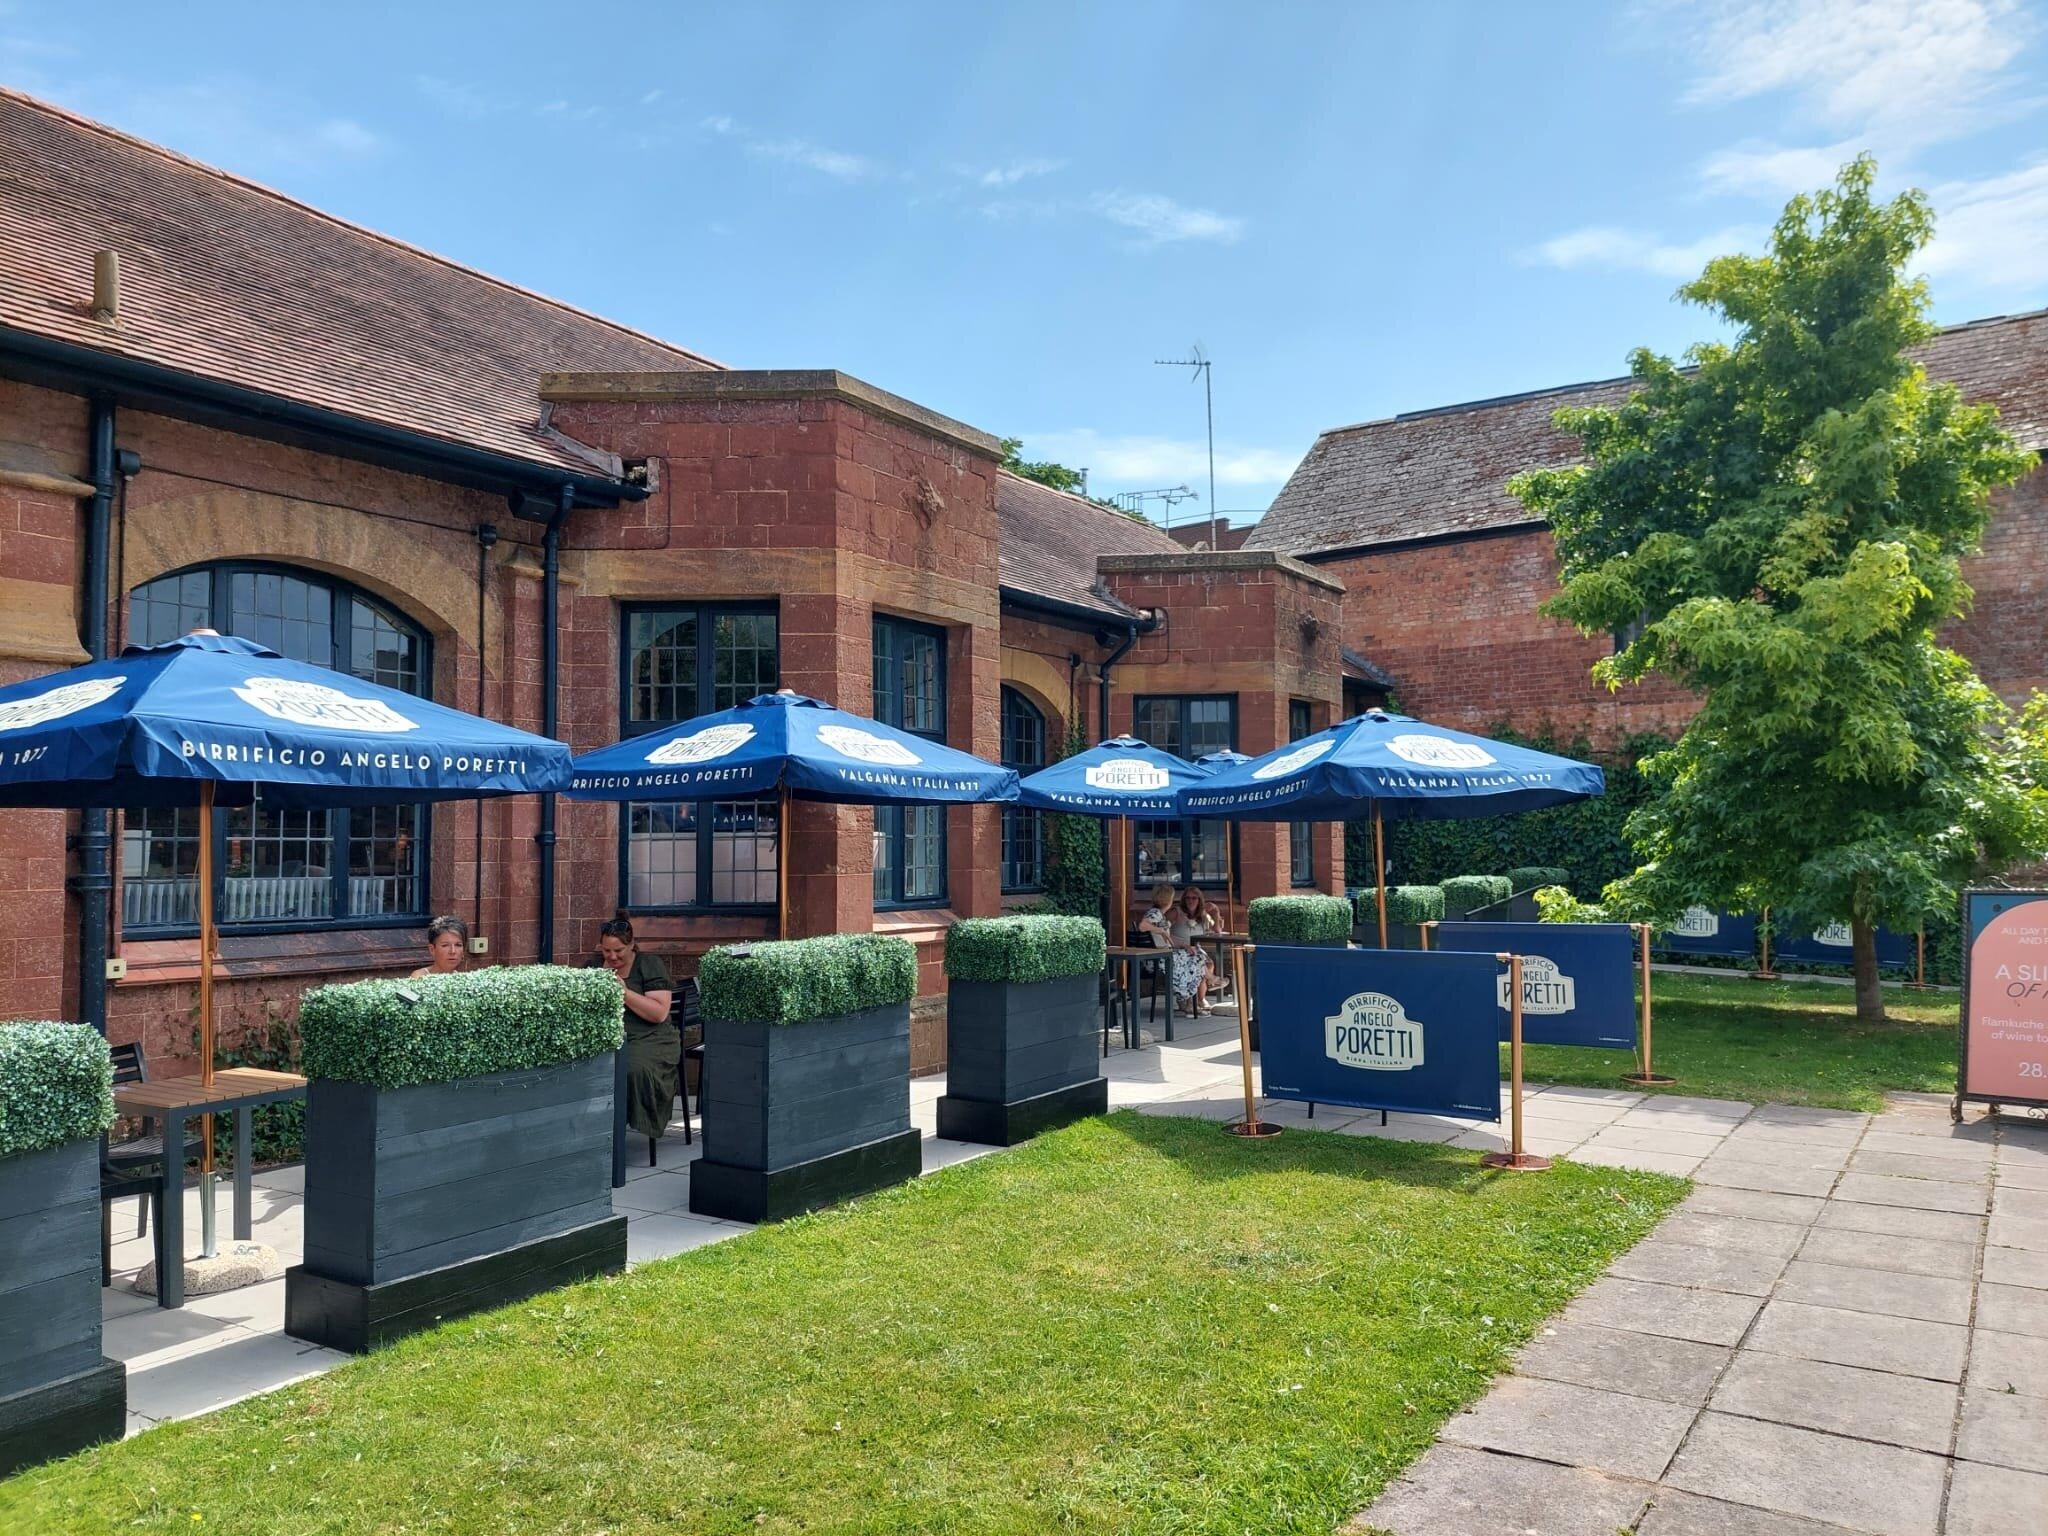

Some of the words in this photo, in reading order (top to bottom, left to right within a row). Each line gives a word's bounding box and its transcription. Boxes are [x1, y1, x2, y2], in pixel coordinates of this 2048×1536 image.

[14, 746, 48, 766] 1877
[182, 740, 326, 766] BIRRIFICIO
[340, 752, 431, 770] ANGELO
[443, 756, 526, 774] PORETTI
[571, 777, 630, 790] RRIFICIO
[637, 772, 690, 786] ANGELO
[696, 767, 753, 782] PORETTI
[839, 768, 907, 786] VALGANNA
[912, 777, 949, 790] ITALIA
[954, 781, 979, 791] 1877
[1095, 772, 1161, 785] PORETTI
[1378, 776, 1459, 788] VALGANNA
[1465, 775, 1517, 787] ITALIA
[1522, 773, 1551, 783] 1877
[1050, 793, 1121, 807] VALGANNA
[1127, 799, 1172, 809] ITALIA
[1187, 795, 1235, 807] BIRRIFICIO
[1238, 790, 1272, 803] ANGELO
[1275, 779, 1309, 797] PORETTI
[1679, 916, 1713, 932] ORETTI
[2020, 927, 2041, 936] DAY
[1520, 970, 1550, 982] NGELO
[1995, 964, 2011, 980] A
[1503, 982, 1566, 1005] PRETTI
[2007, 982, 2042, 998] OF
[1347, 996, 1400, 1014] BIRRIFICIO
[1353, 1011, 1394, 1028] ANGELO
[1982, 1016, 2044, 1030] Flamkuche
[1335, 1026, 1414, 1059] PORETTI
[1991, 1030, 2004, 1040] of
[2005, 1031, 2034, 1042] wine
